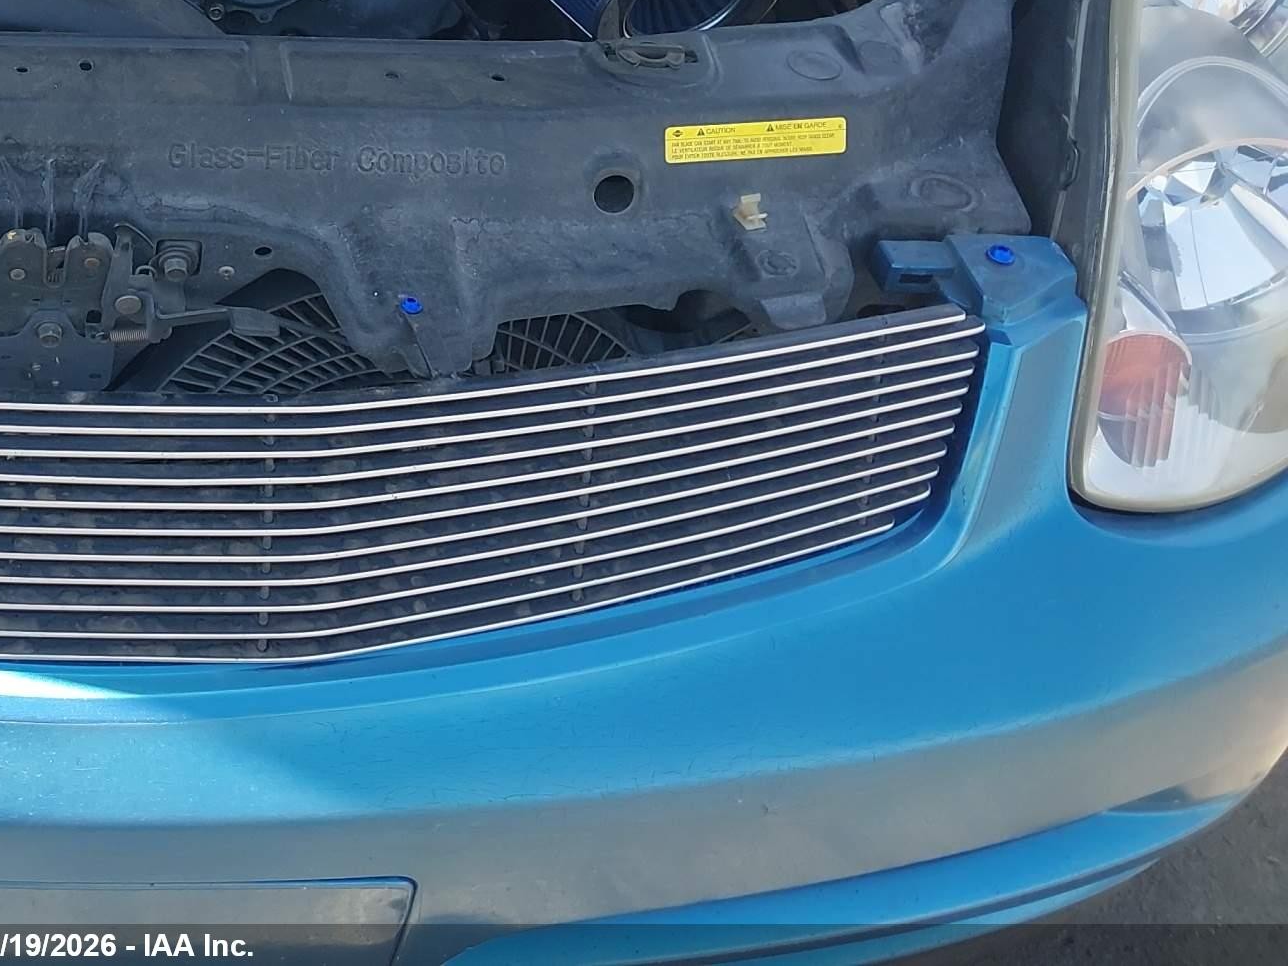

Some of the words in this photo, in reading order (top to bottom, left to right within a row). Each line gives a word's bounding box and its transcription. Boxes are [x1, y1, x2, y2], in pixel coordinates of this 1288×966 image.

[804, 121, 827, 129] GARDE
[706, 127, 736, 135] CAUTION
[169, 142, 341, 171] Glass-Fiber
